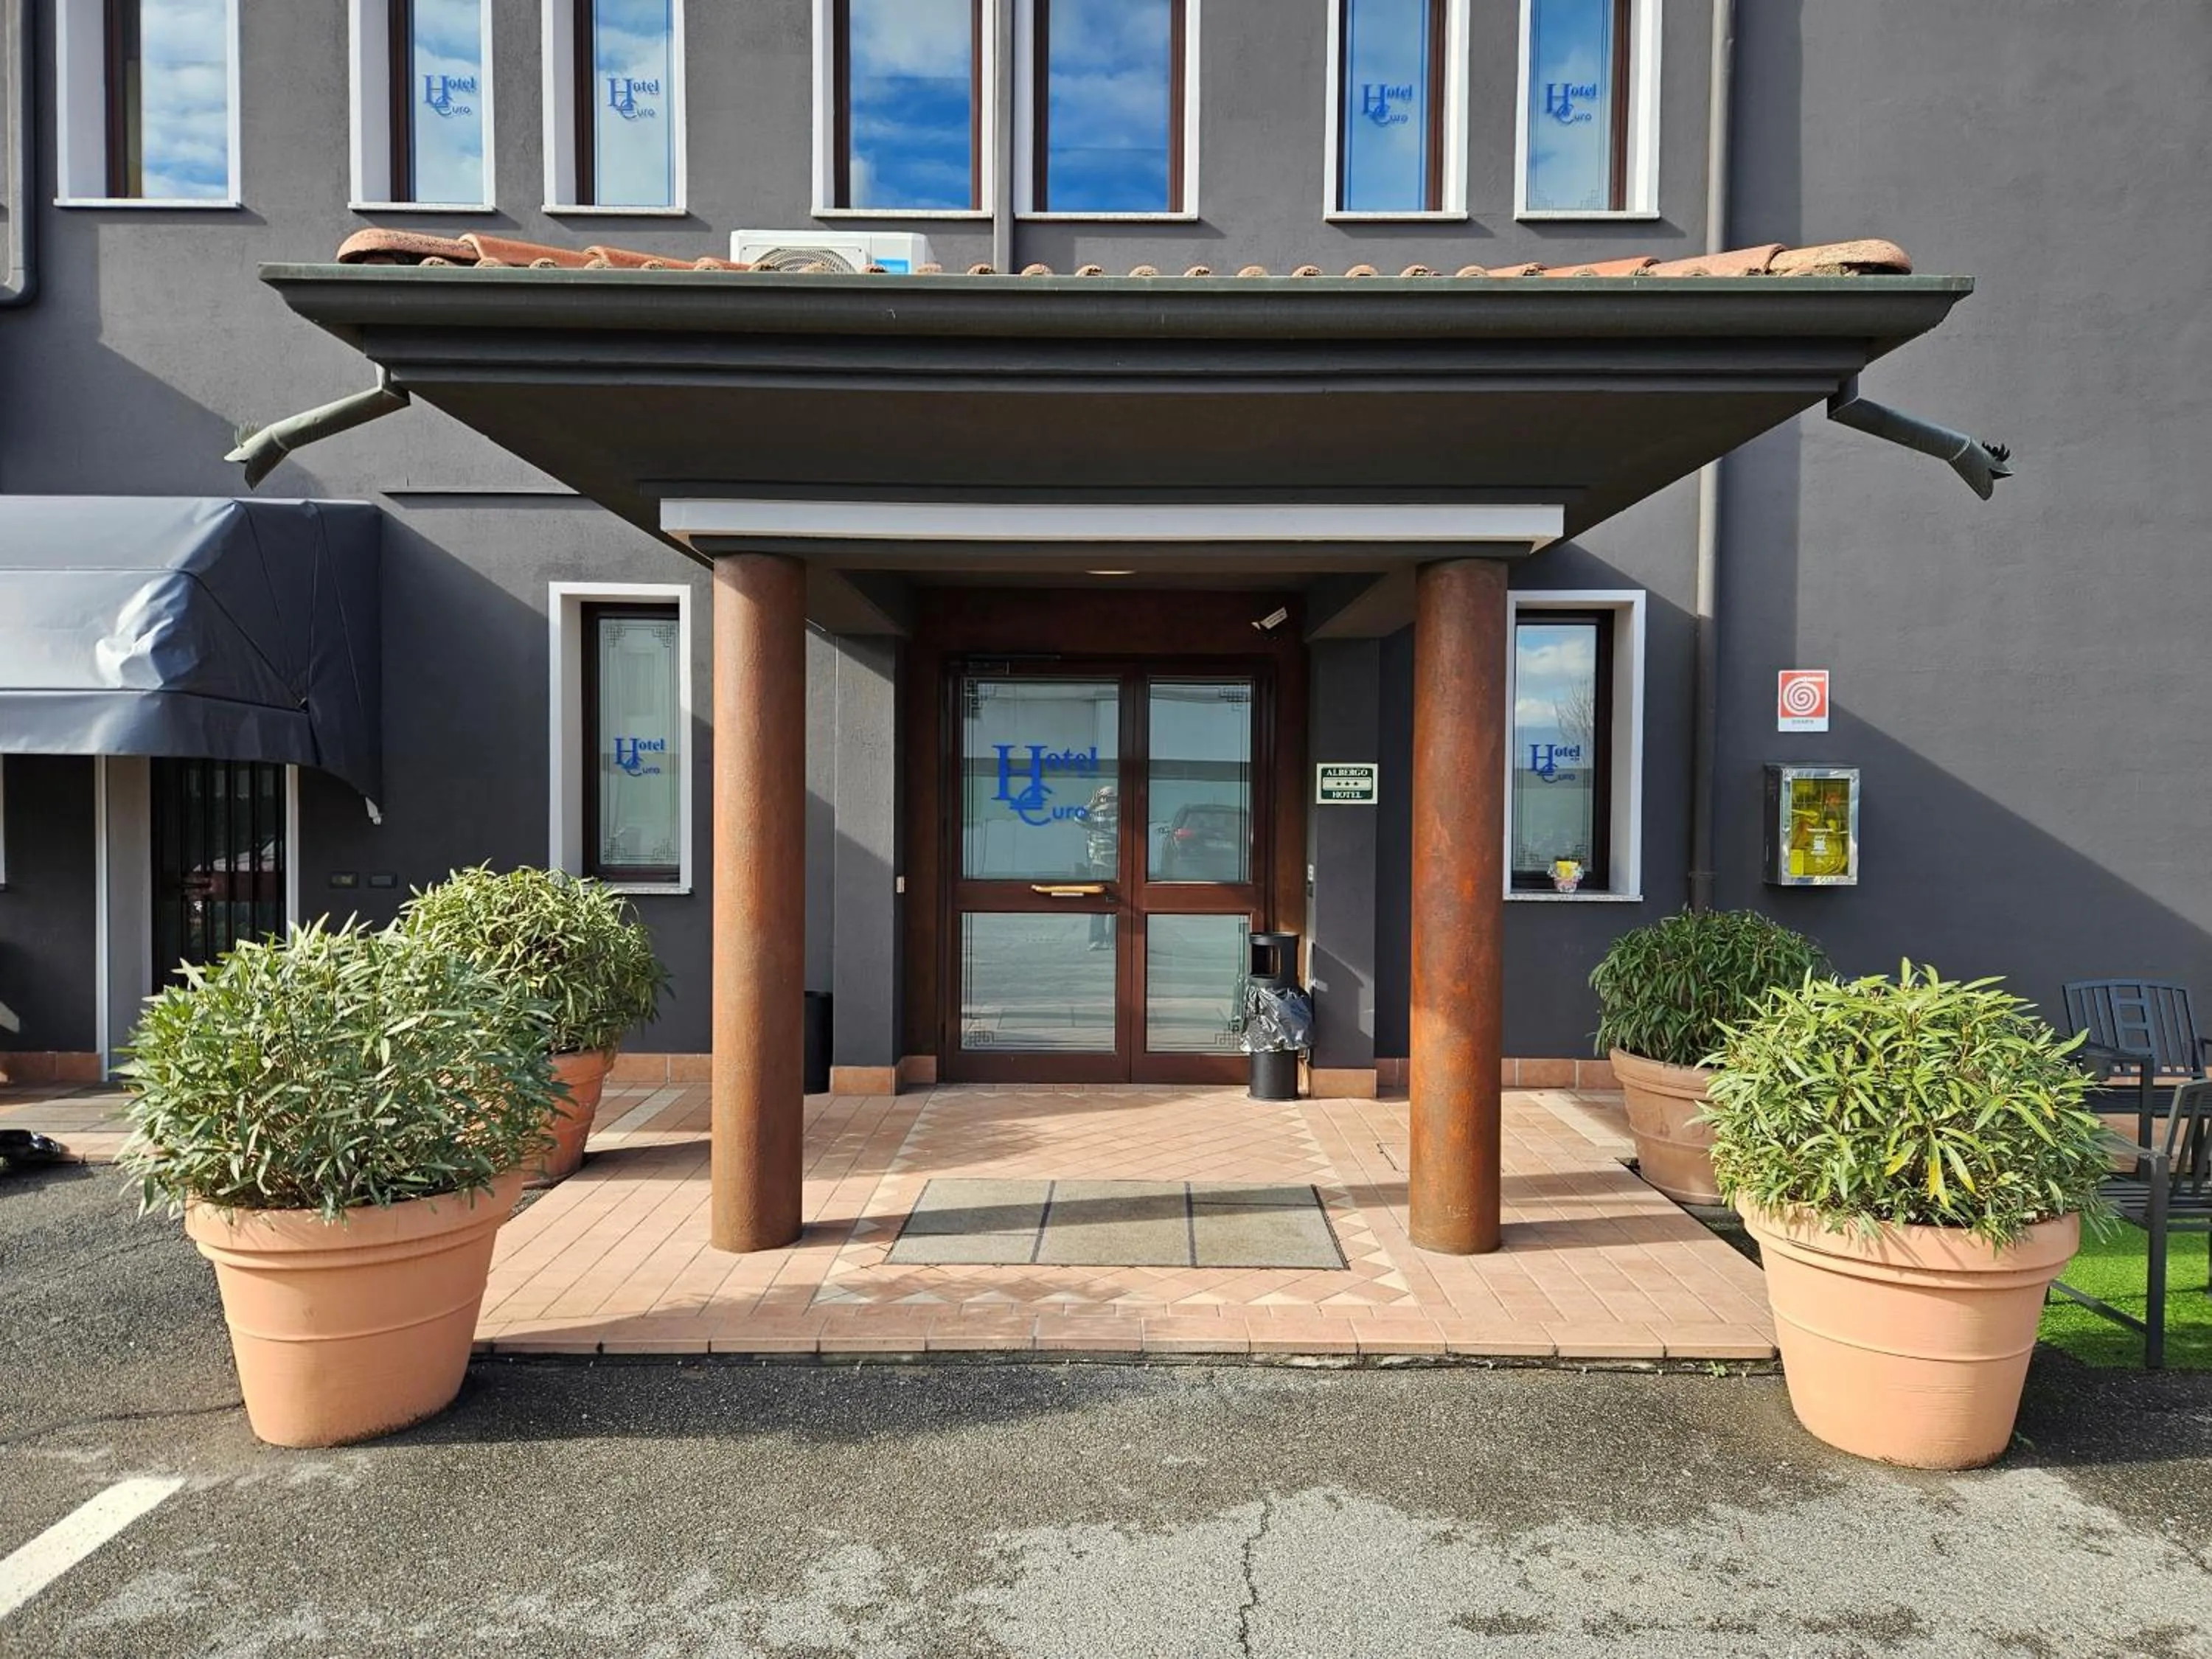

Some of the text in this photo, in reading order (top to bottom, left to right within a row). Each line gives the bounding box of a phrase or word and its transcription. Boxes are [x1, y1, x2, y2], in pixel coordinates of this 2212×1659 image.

[423, 74, 477, 104] Hotel
[608, 78, 659, 107] Hotel
[1362, 83, 1413, 115] Hotel
[1546, 83, 1596, 114] Hotel
[613, 738, 664, 765] Hotel
[1528, 744, 1580, 772] Hotel
[991, 745, 1097, 800] Hotel
